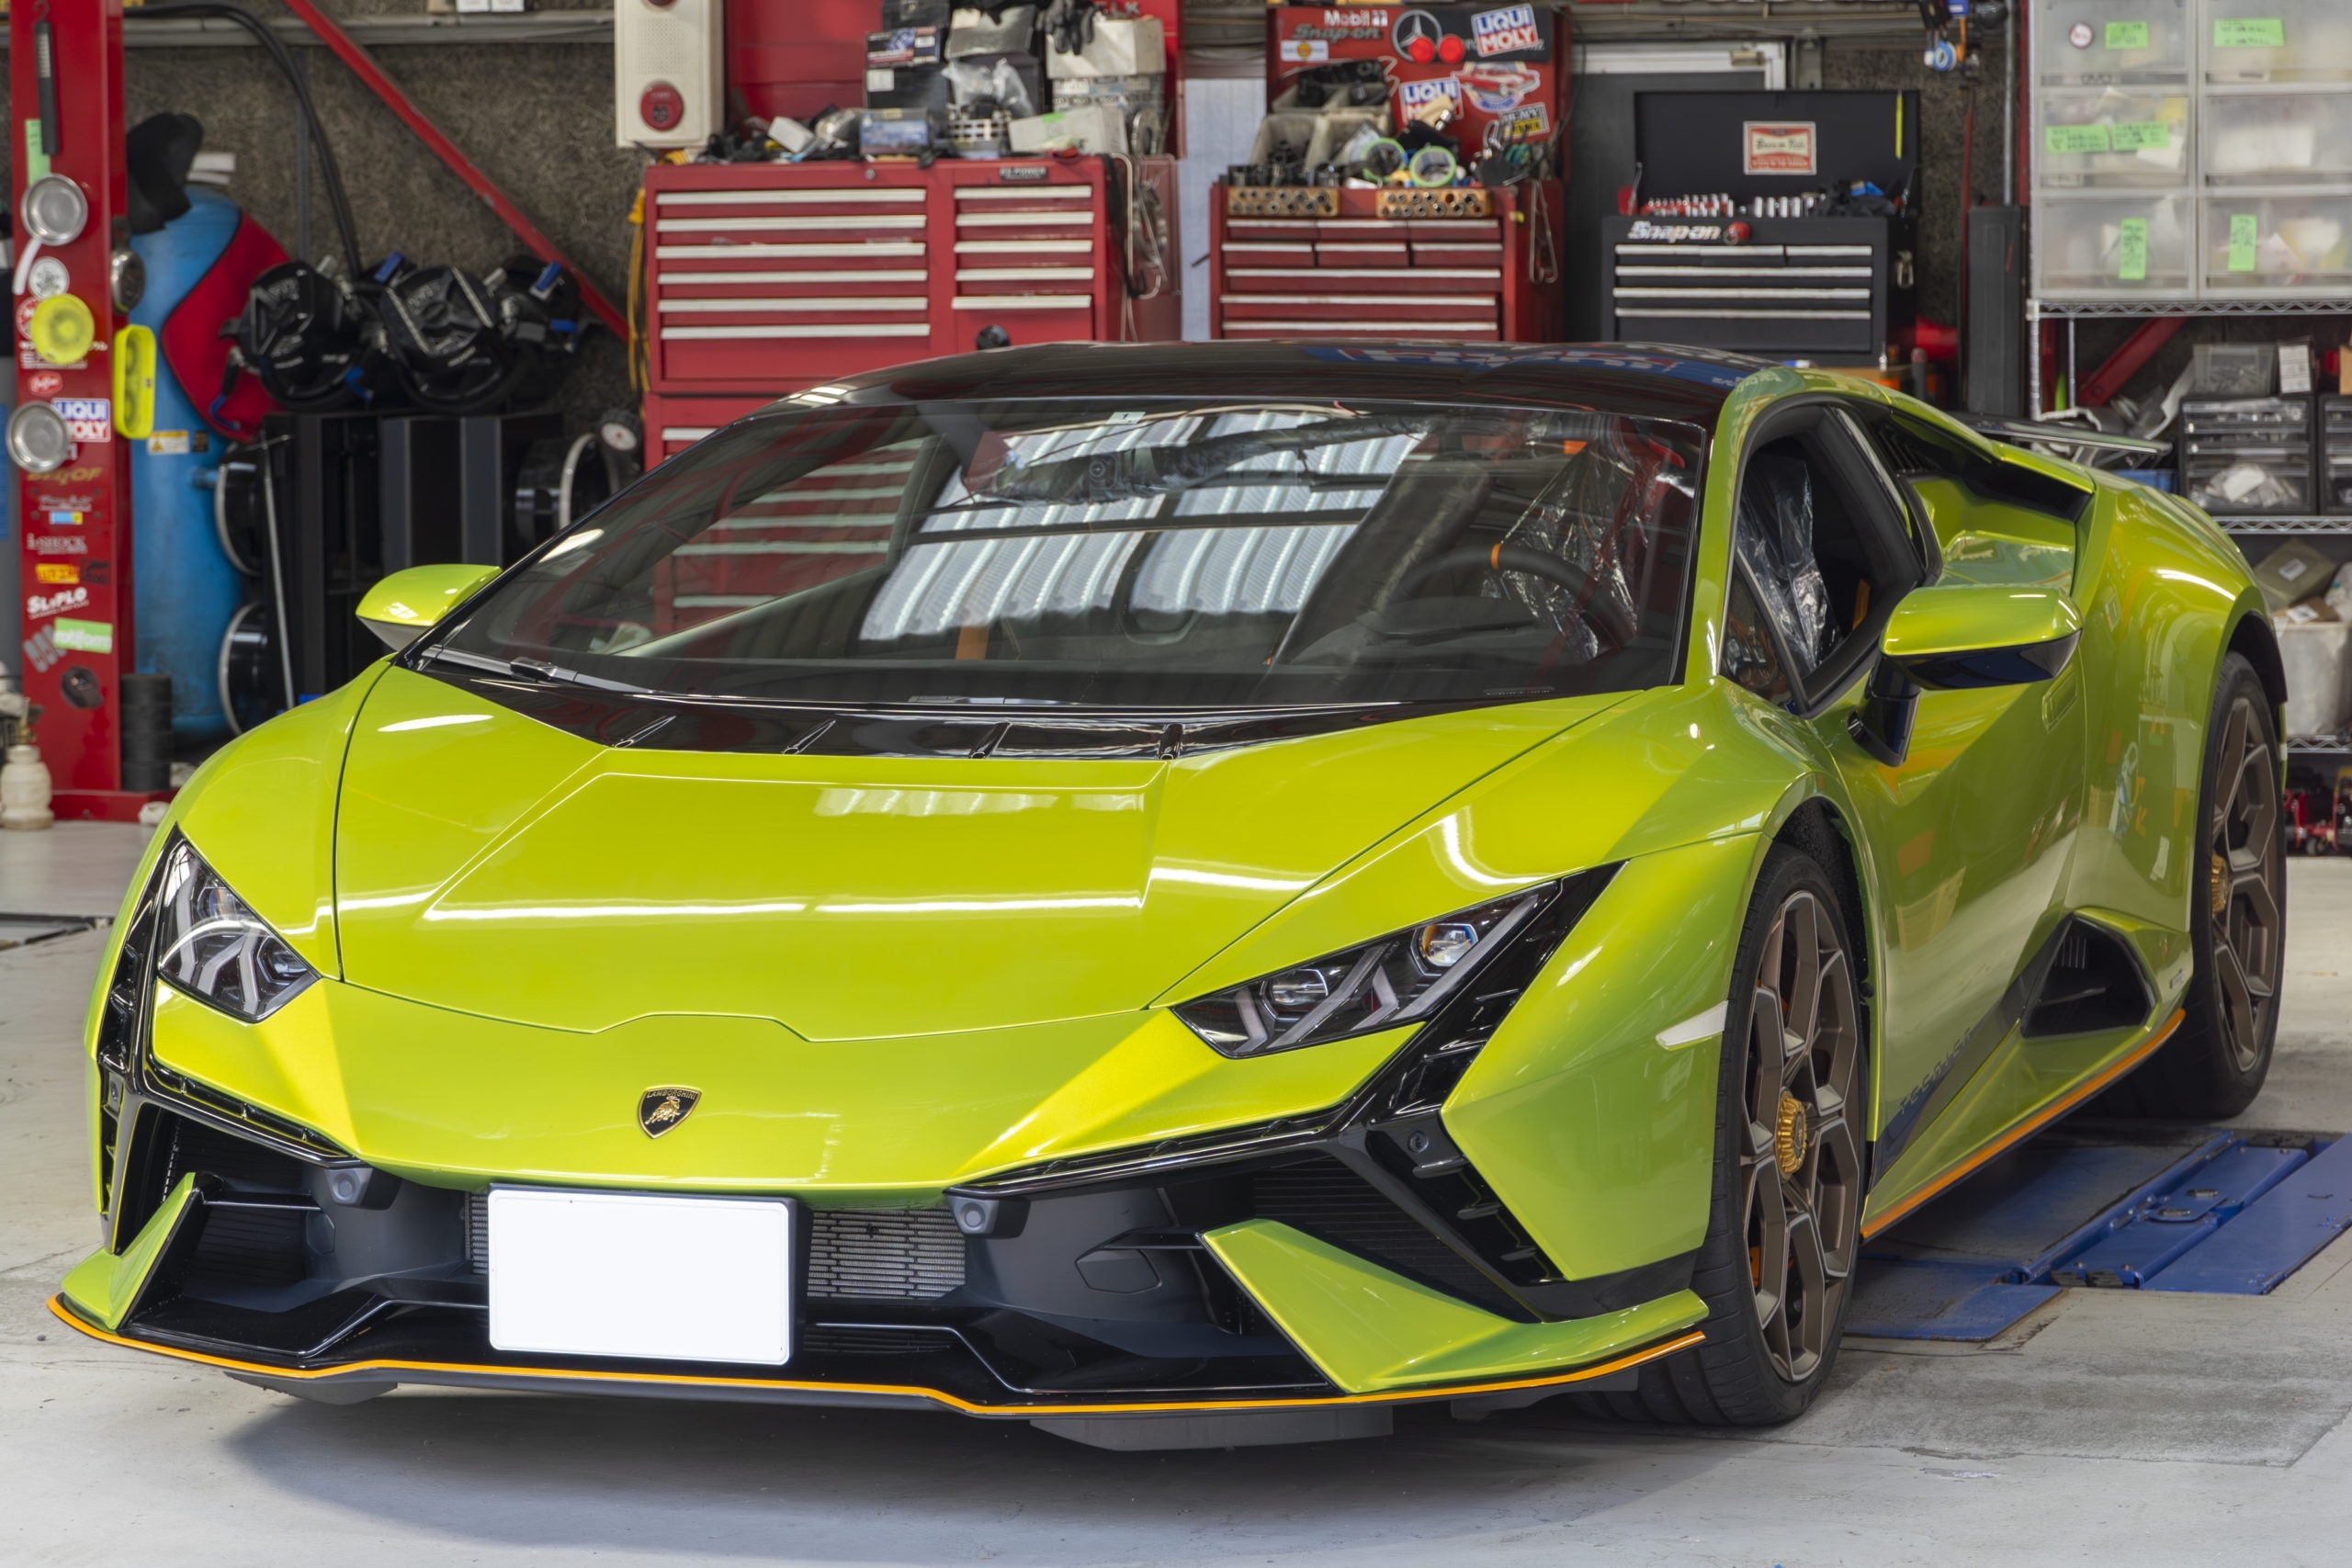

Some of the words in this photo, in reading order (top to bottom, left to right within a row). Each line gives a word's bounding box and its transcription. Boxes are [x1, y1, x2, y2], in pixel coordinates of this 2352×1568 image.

[1324, 9, 1370, 27] Mobil
[1476, 7, 1530, 35] LIQUI
[1292, 23, 1382, 45] Snap-on
[1479, 27, 1535, 53] MOLY
[1404, 81, 1457, 104] LIQUI
[1627, 220, 1722, 243] Snap-on
[646, 1089, 696, 1100] LAMBORGHINI
